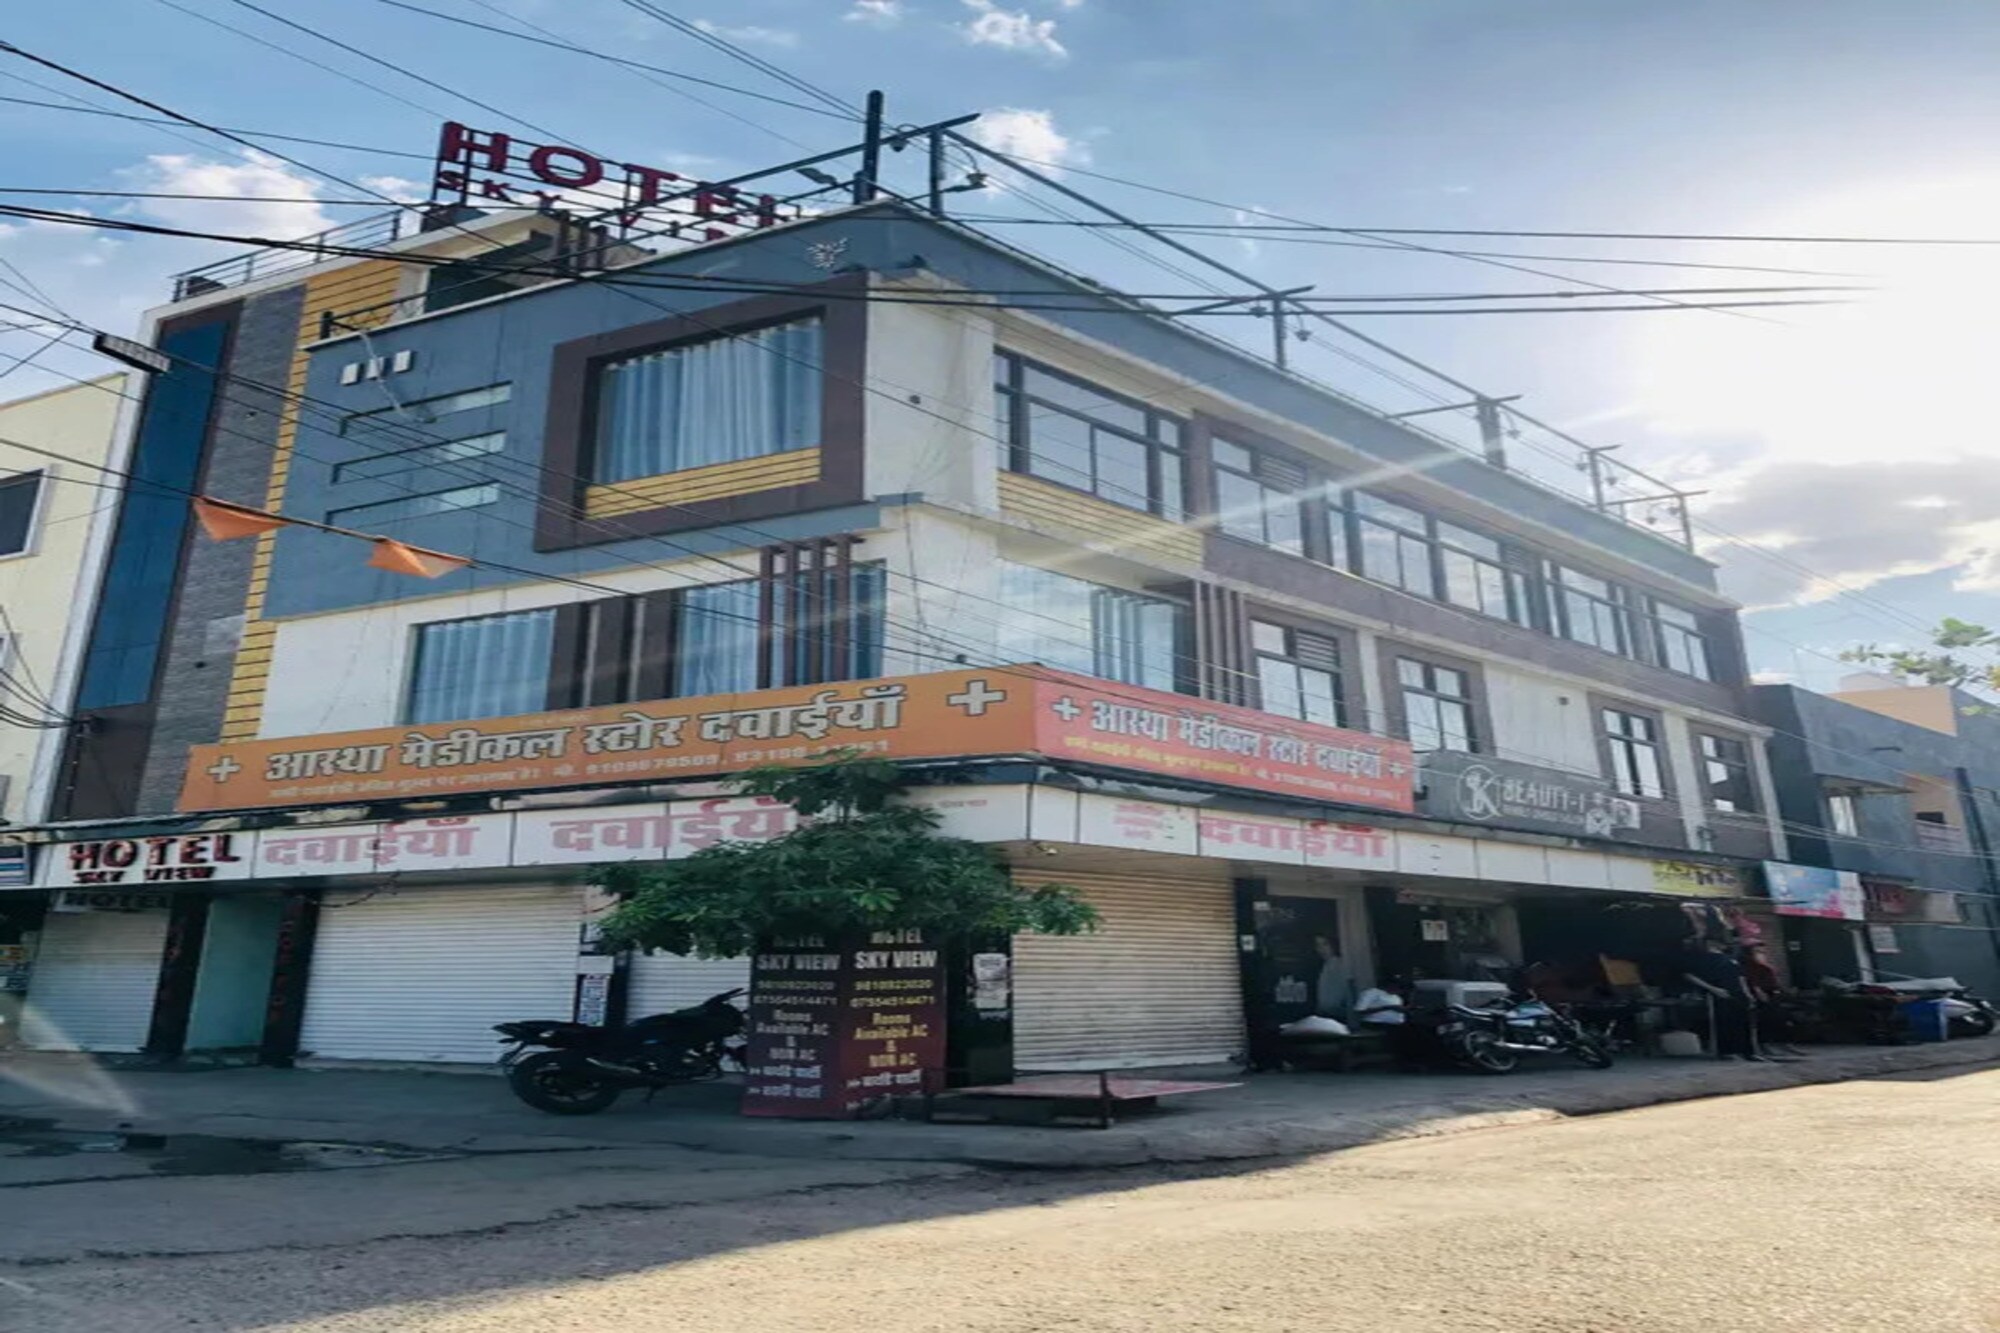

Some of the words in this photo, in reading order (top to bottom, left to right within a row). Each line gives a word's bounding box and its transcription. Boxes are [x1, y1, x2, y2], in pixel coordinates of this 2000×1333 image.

[265, 743, 393, 781] आस्था
[400, 728, 571, 768] मेडीकल
[582, 711, 692, 755] स्टोर
[70, 834, 241, 869] HOTEL
[74, 871, 126, 884] SKY
[144, 866, 218, 882] VIEW
[757, 954, 791, 970] SKY
[794, 954, 841, 970] VIEW
[854, 950, 892, 969] SKY
[893, 950, 938, 968] VIEW
